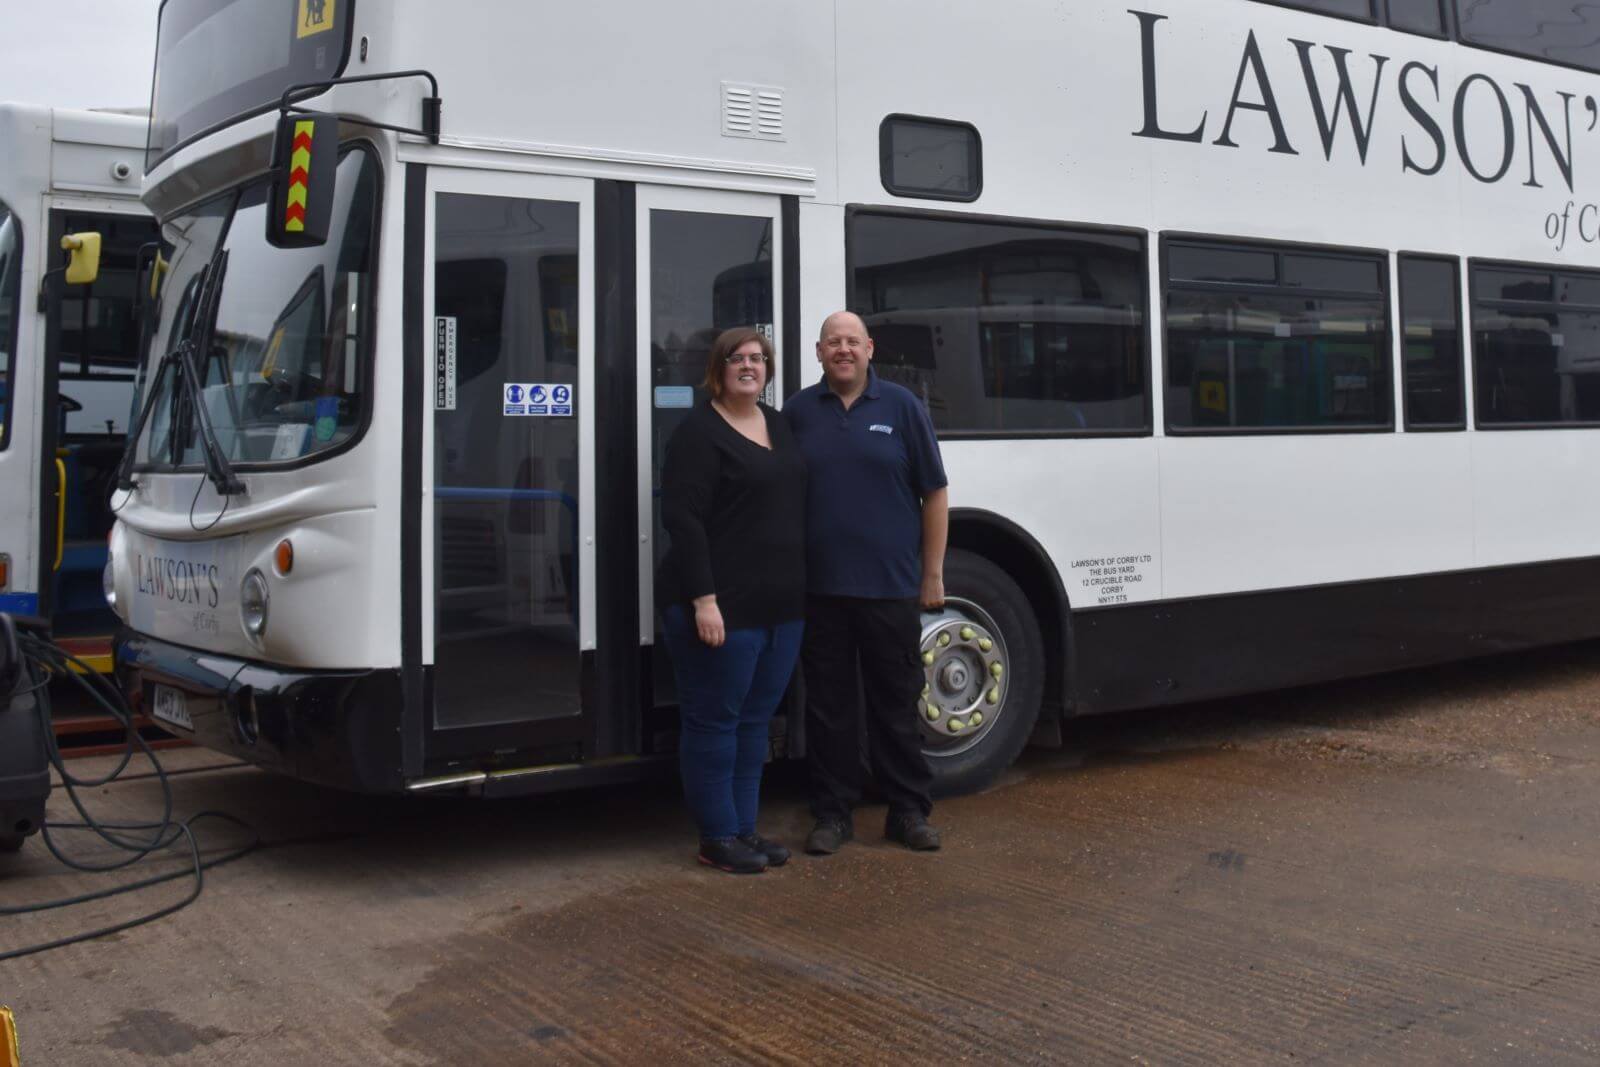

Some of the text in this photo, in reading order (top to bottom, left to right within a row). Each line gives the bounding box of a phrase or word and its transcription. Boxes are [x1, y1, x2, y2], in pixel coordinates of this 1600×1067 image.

[1545, 200, 1600, 252] of C
[1071, 554, 1152, 568] LAWSON'S OF CORBY LTD
[1089, 565, 1135, 576] THE BUS YARD
[137, 554, 218, 609] LAWSON'S
[1091, 576, 1123, 586] CRUCIBLE
[1124, 574, 1143, 582] ROAD
[1101, 585, 1124, 594] CORBY
